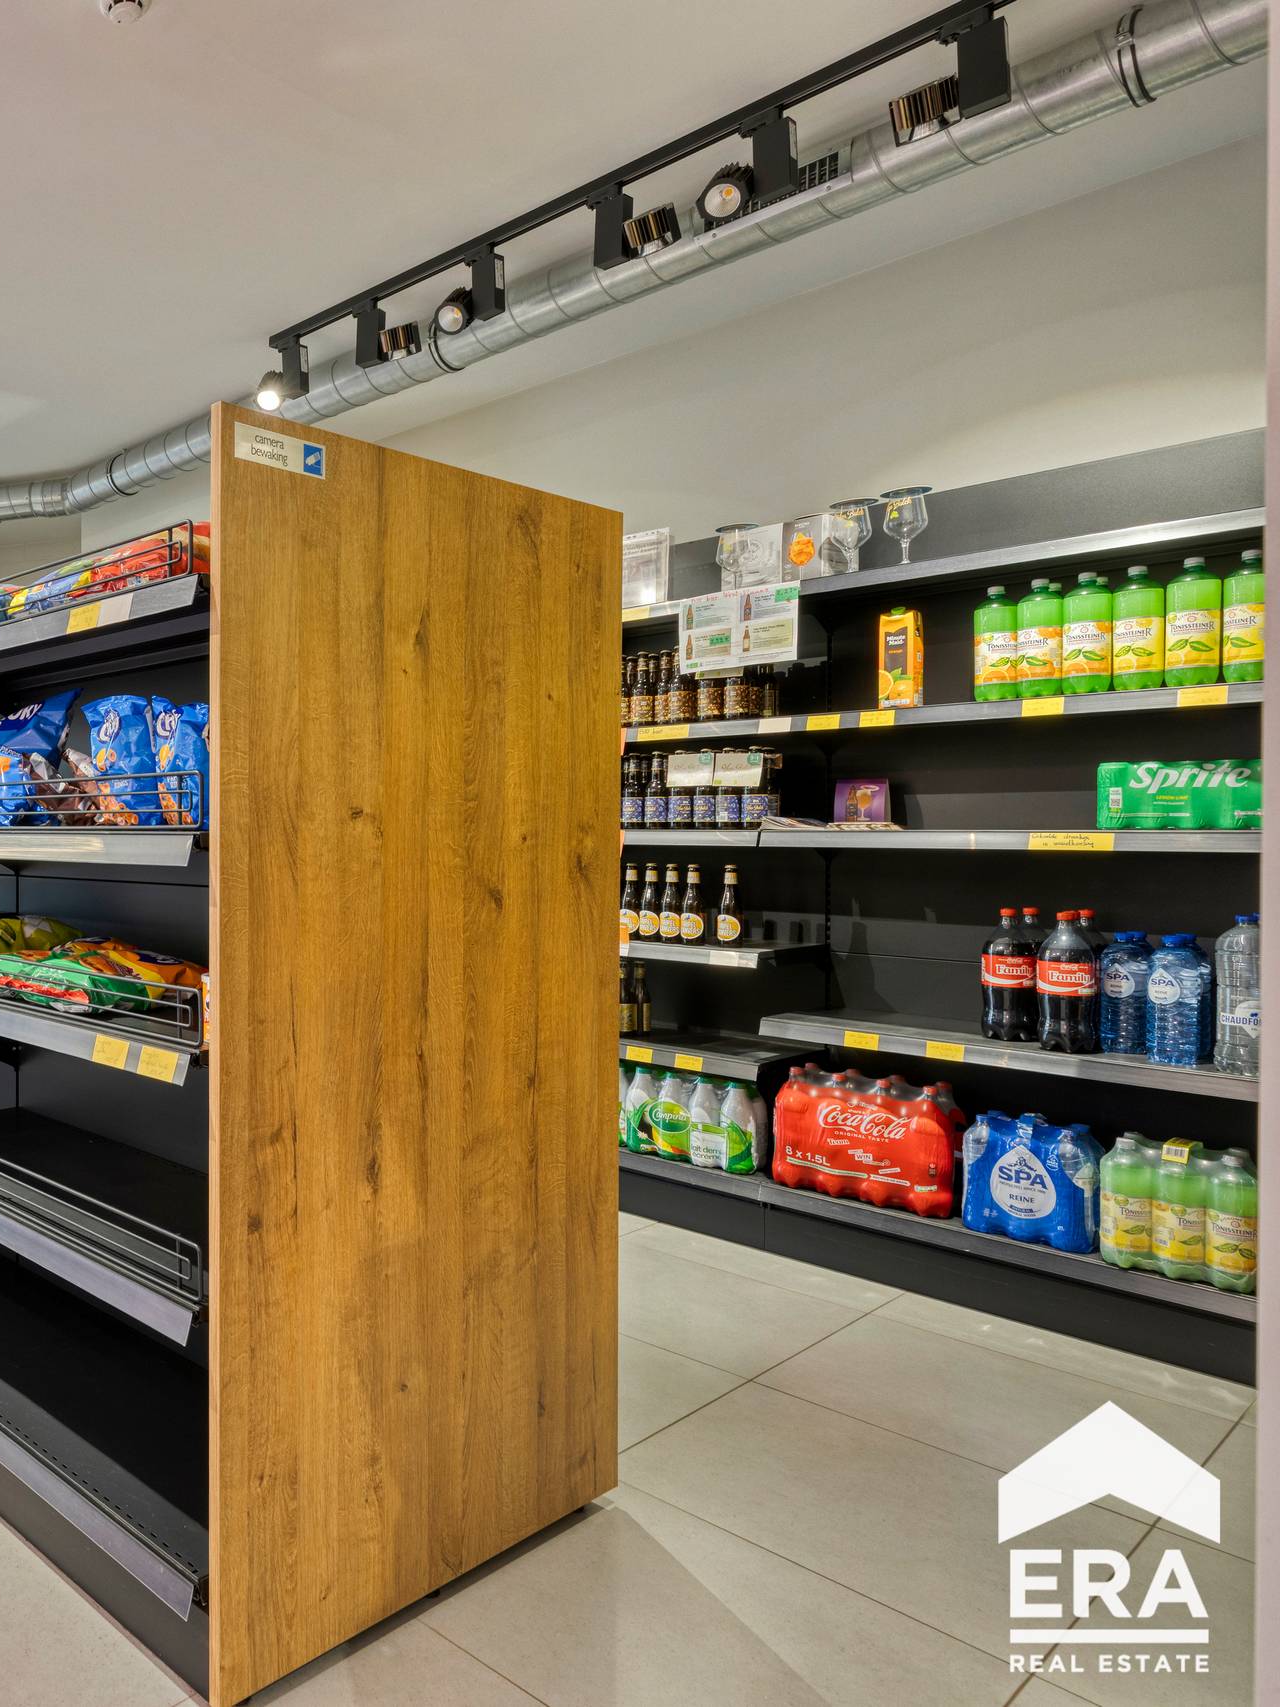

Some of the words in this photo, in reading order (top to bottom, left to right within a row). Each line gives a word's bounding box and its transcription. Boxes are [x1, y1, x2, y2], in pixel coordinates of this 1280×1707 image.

[254, 434, 285, 450] camera
[250, 443, 289, 467] bewaking
[1128, 761, 1252, 794] Sprite
[995, 963, 1032, 977] Family
[1047, 970, 1091, 985] Family
[1106, 973, 1130, 982] SPA
[1150, 978, 1175, 988] SPA
[1221, 1013, 1261, 1026] CHAUDFO
[652, 1108, 687, 1123] Campina
[834, 1130, 866, 1140] ORIGINAL
[868, 1135, 889, 1144] TASTE
[785, 1145, 793, 1156] 8
[796, 1151, 803, 1159] x
[806, 1152, 831, 1167] 1.5L
[997, 1165, 1049, 1191] SPA
[1008, 1193, 1036, 1204] REINE
